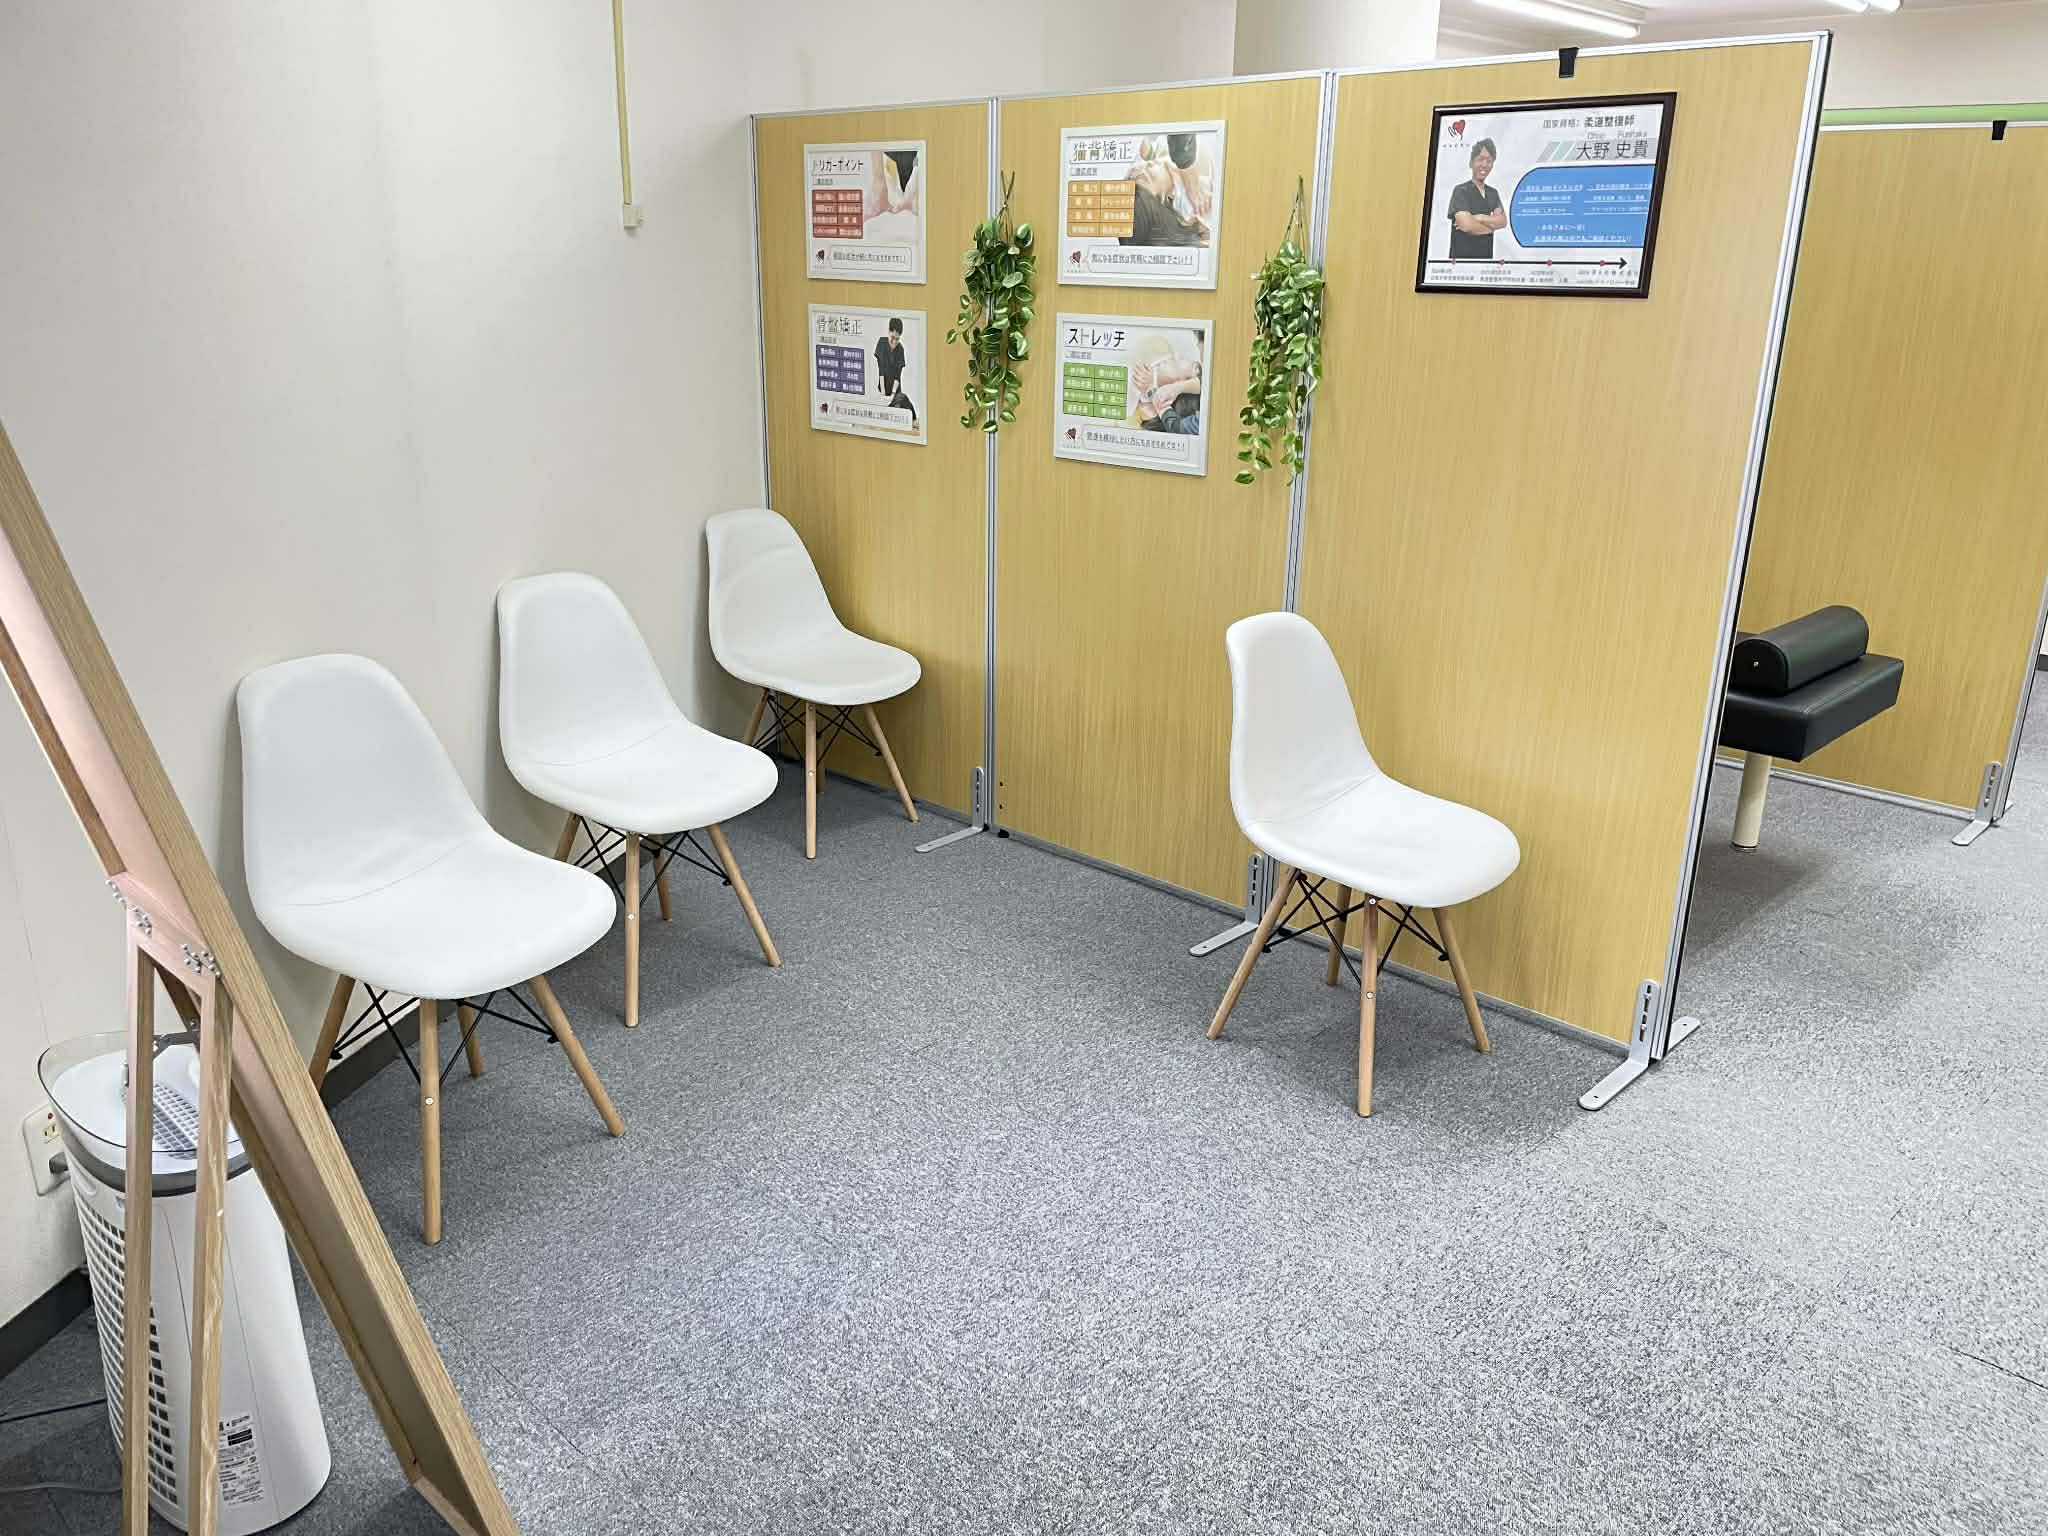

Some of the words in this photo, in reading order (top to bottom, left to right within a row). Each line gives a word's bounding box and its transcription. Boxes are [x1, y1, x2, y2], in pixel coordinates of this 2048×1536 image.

[1072, 140, 1133, 161] 猫背矯正
[1576, 141, 1611, 160] 大野
[1616, 140, 1649, 159] 史貴
[1068, 328, 1125, 348] ストレッチ
